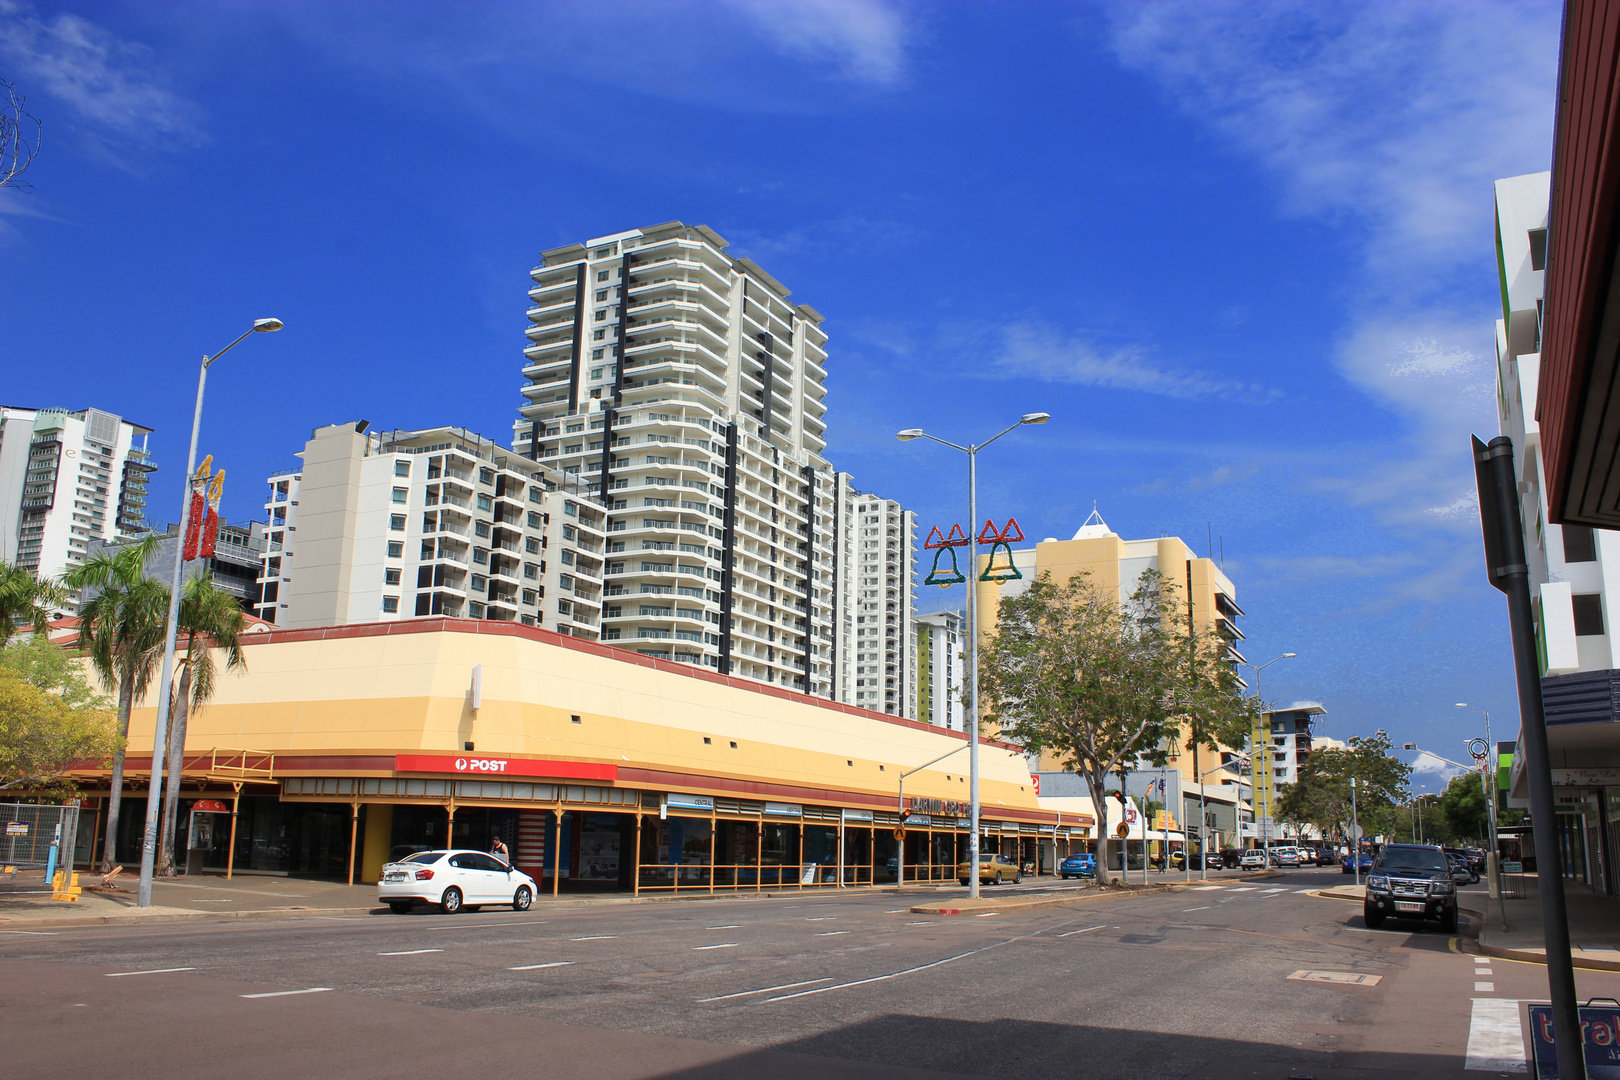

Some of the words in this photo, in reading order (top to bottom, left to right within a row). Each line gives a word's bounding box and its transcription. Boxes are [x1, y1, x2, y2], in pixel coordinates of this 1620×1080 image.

[470, 759, 508, 772] POST
[911, 797, 943, 814] DARWIN
[944, 800, 960, 816] GPO
